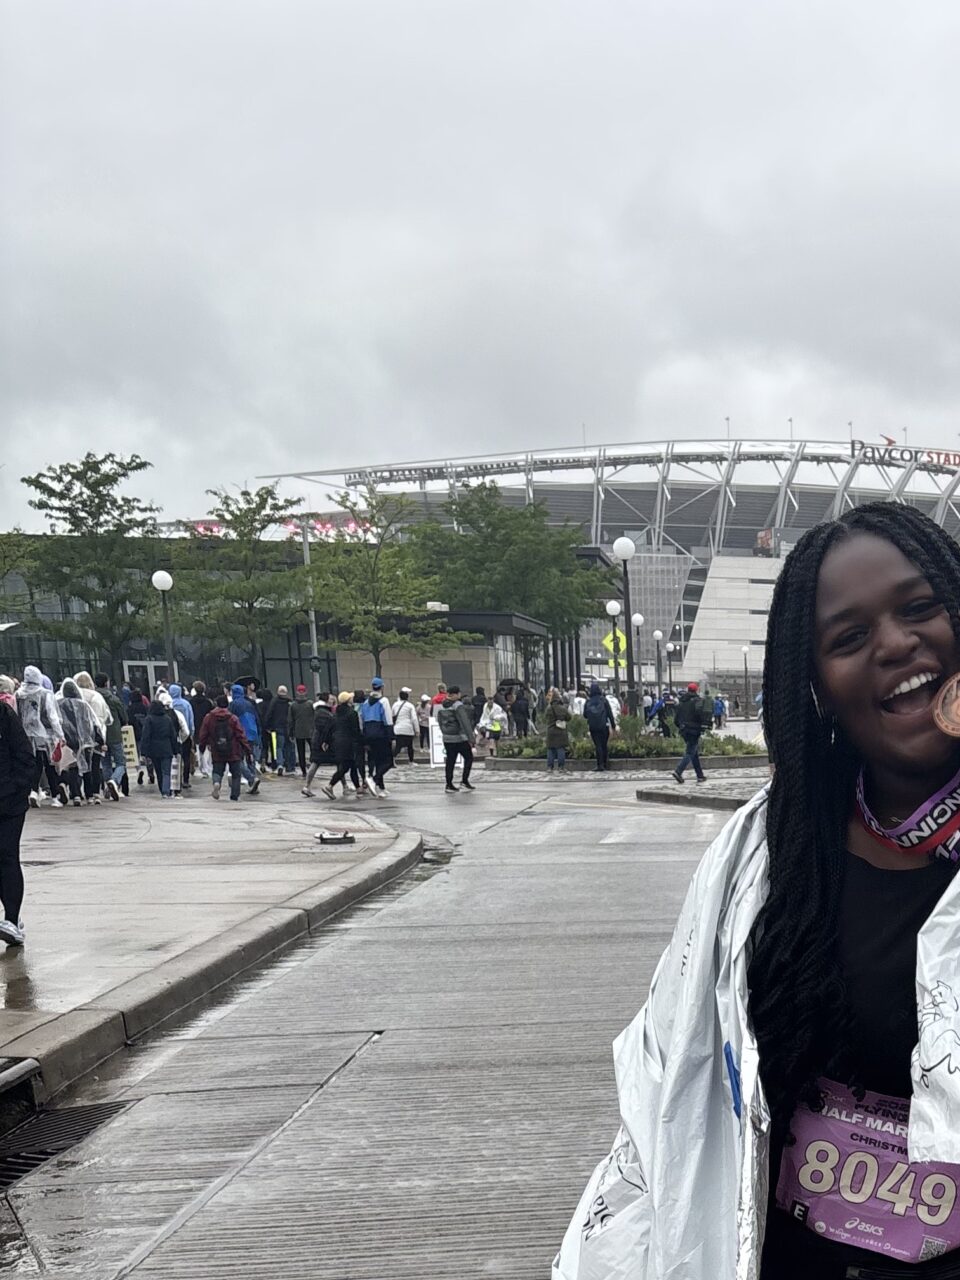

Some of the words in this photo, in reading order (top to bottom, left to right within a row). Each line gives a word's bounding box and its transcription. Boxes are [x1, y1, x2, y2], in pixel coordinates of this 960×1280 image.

[851, 440, 923, 465] Paycor
[797, 1139, 957, 1226] 8049
[793, 1203, 805, 1220] E
